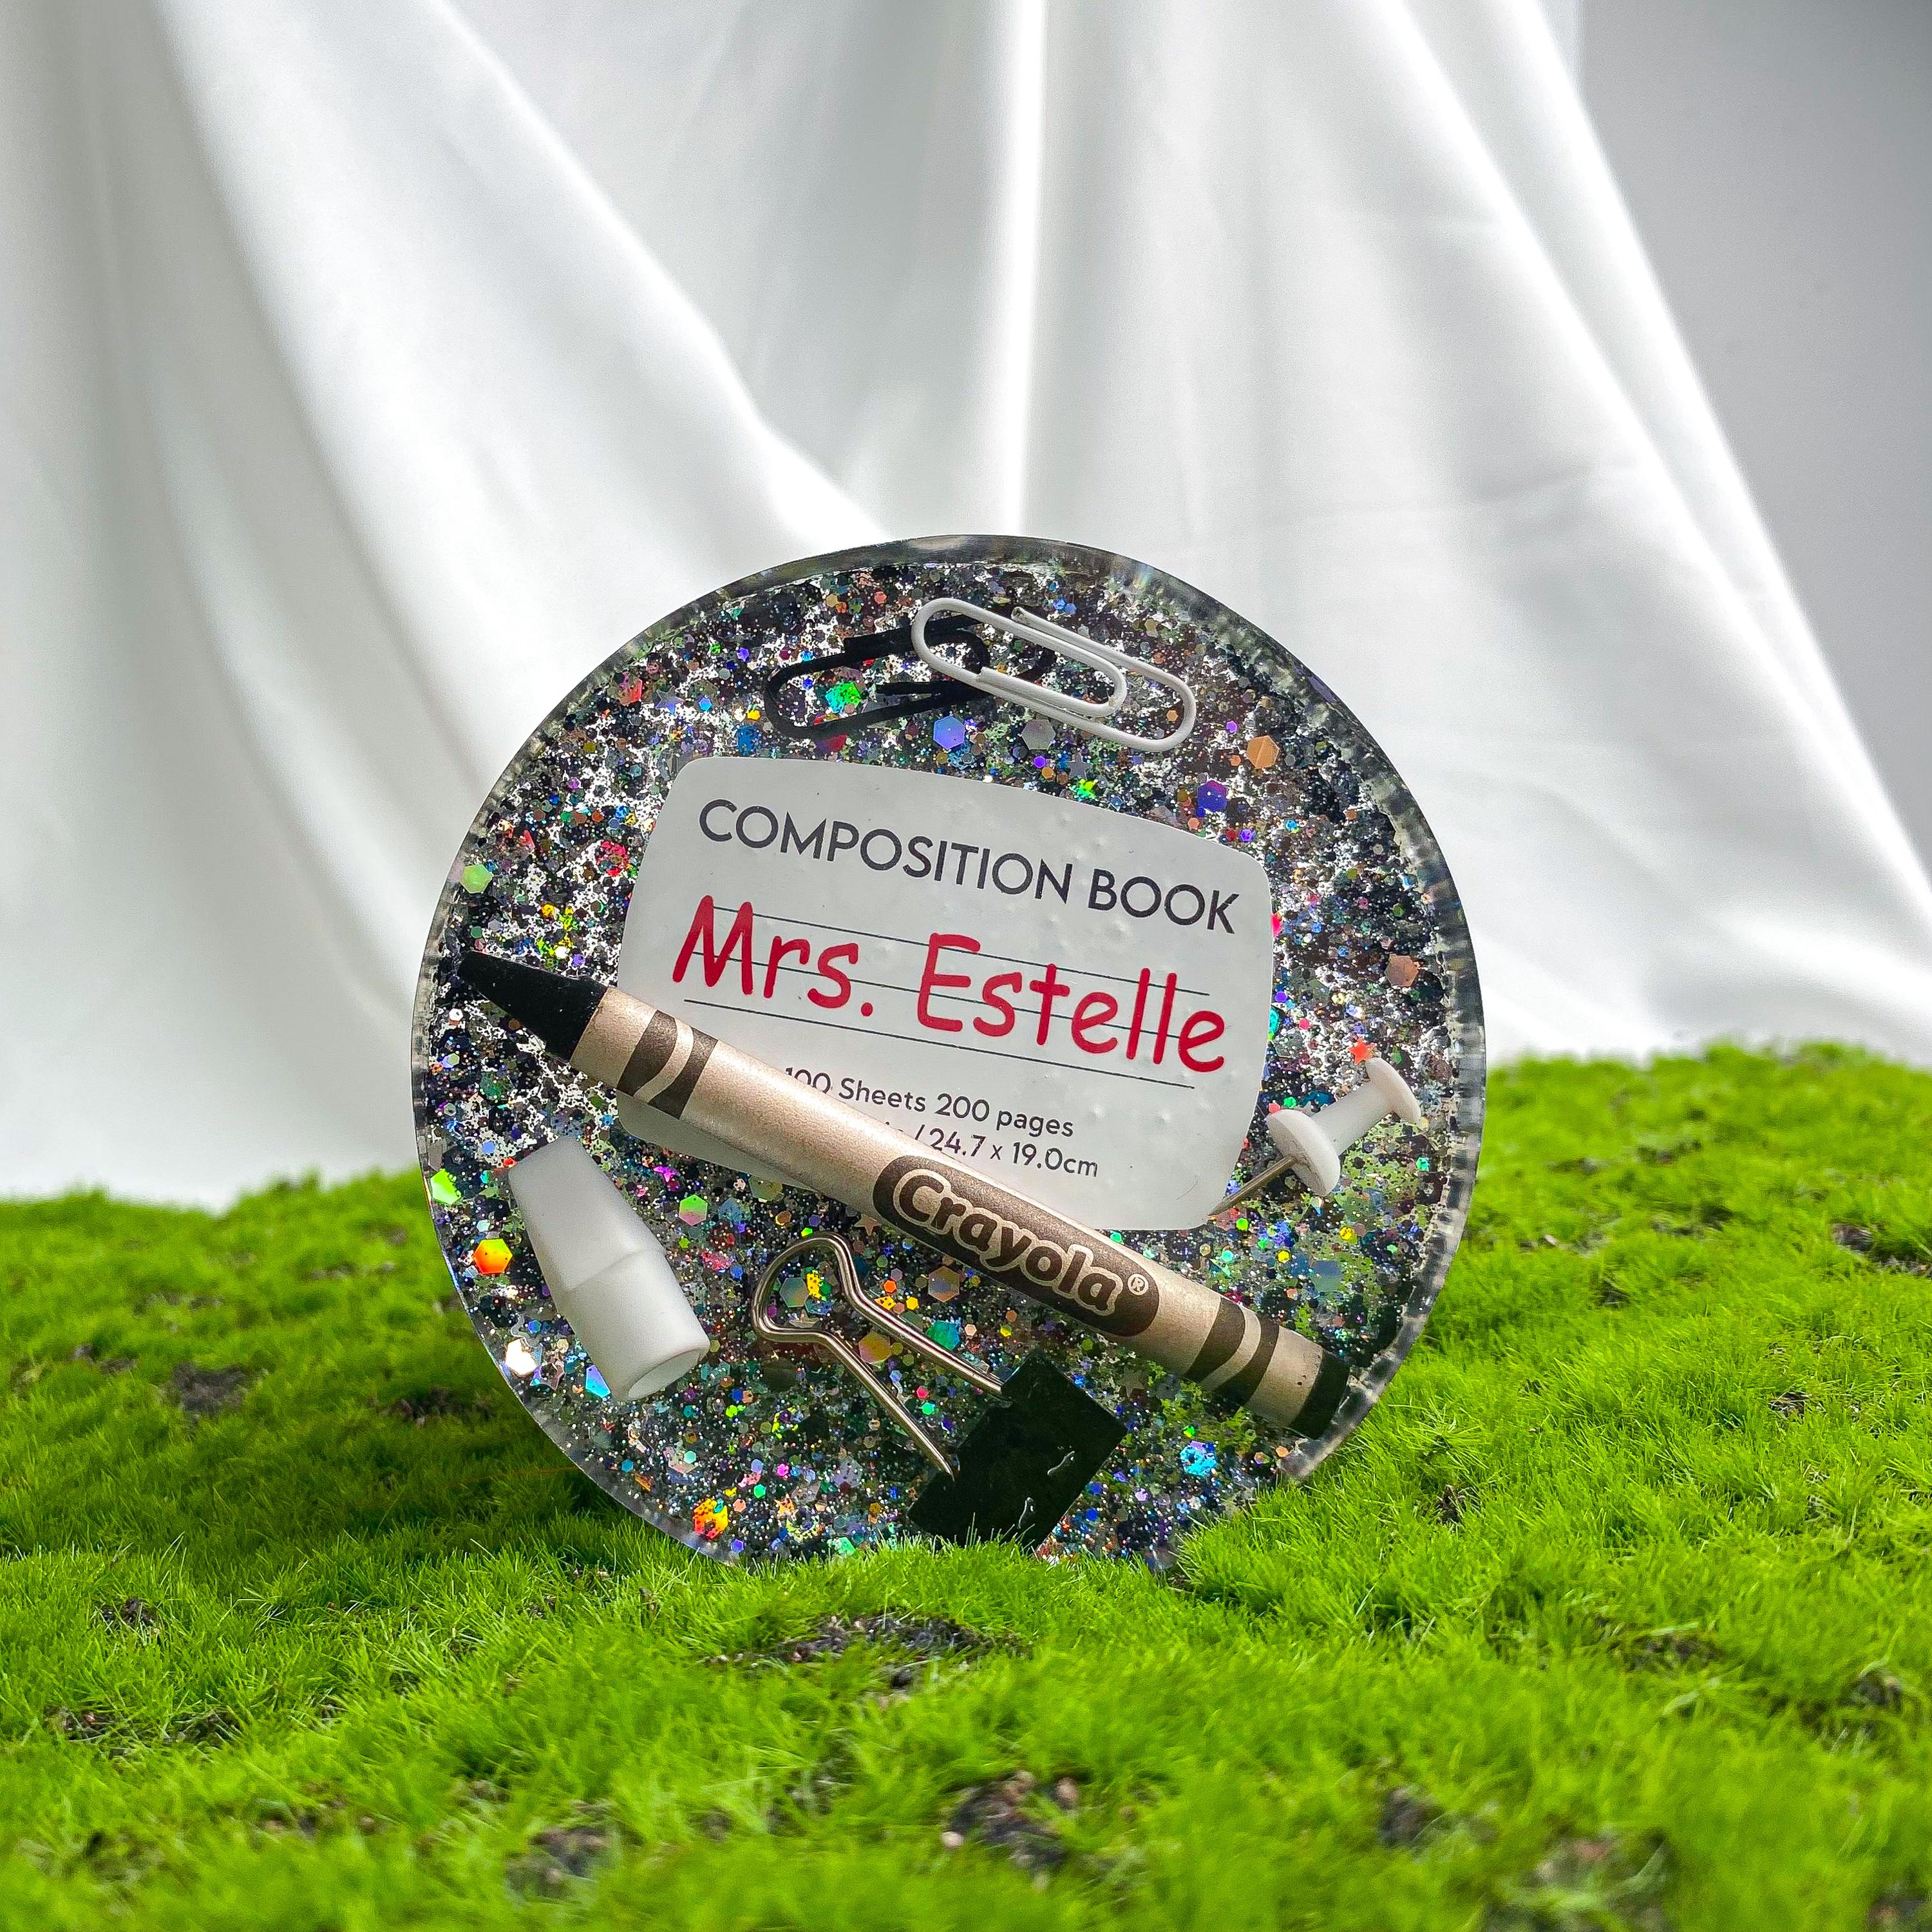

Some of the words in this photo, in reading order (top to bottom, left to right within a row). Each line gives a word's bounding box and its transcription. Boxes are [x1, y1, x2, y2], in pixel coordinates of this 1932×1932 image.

[699, 799, 1074, 904] COMPOSITION
[1087, 868, 1239, 934] BOOK
[672, 895, 874, 1018] Mrs.
[916, 932, 1225, 1073] Estelle
[838, 1077, 926, 1112] Sheets
[934, 1094, 990, 1121] 200
[996, 1108, 1074, 1138] pages
[929, 1128, 987, 1157] 24.7
[990, 1144, 1003, 1160] x
[1013, 1142, 1099, 1177] 19.0cm
